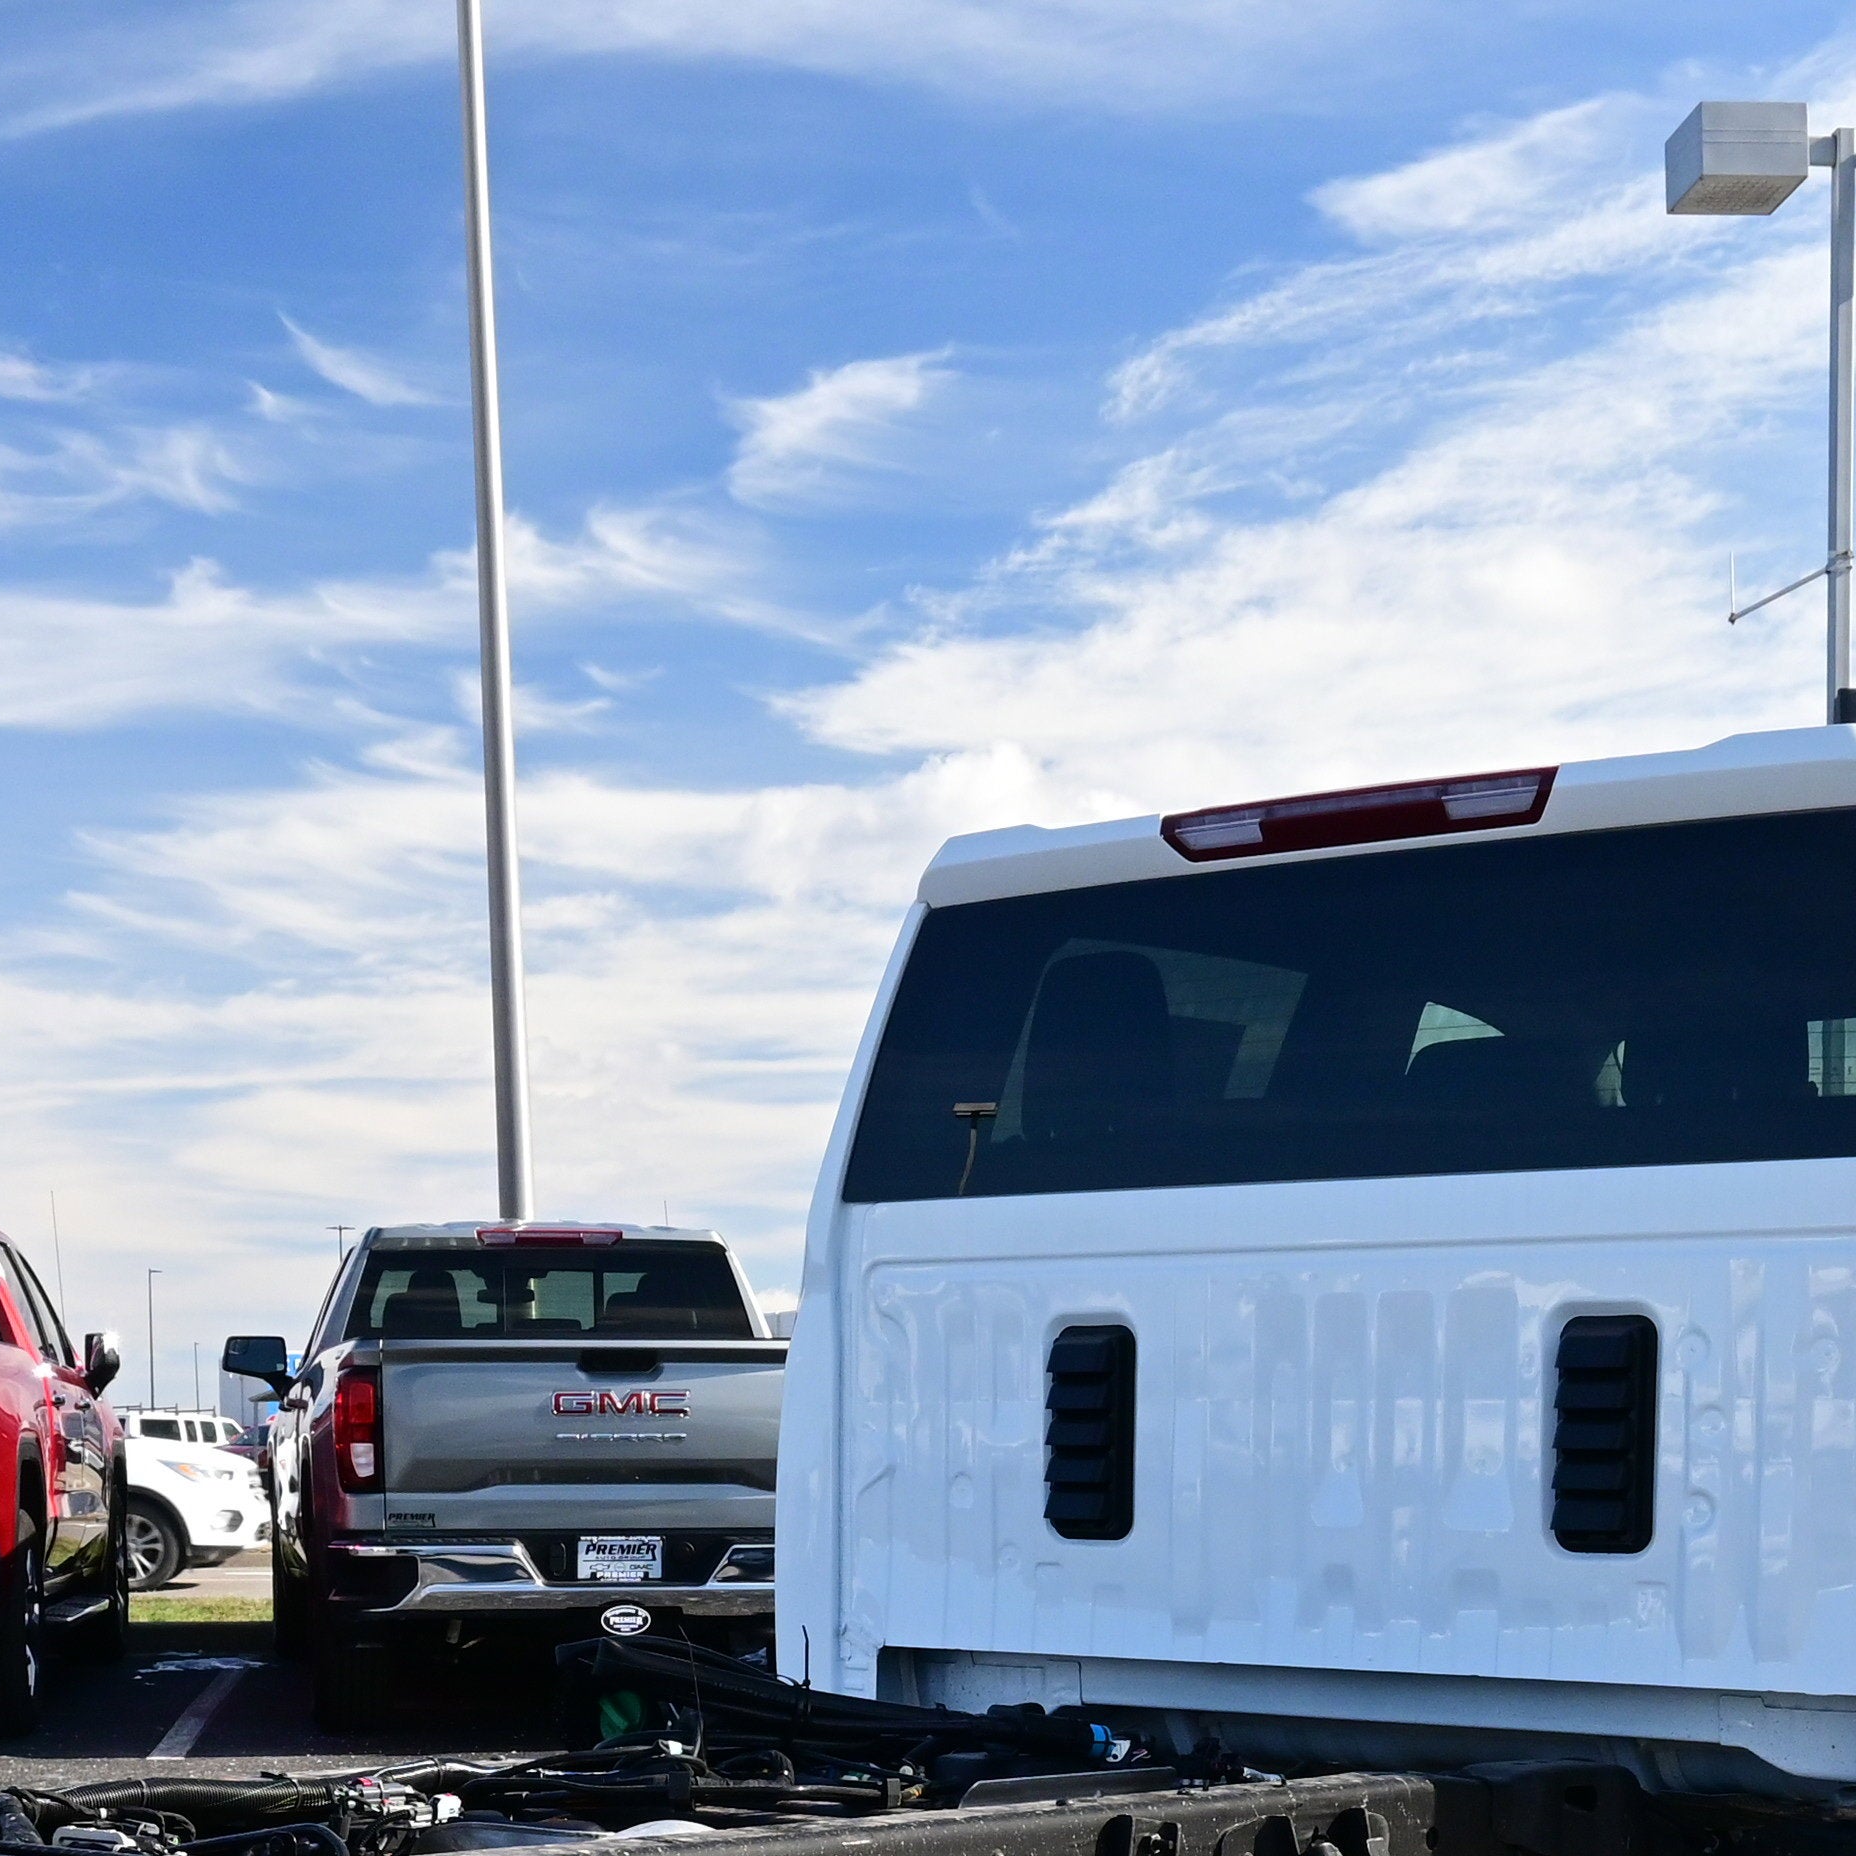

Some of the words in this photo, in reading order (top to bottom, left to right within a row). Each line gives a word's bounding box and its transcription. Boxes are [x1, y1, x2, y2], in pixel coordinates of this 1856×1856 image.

[551, 1390, 691, 1418] GMC
[387, 1512, 436, 1523] PREMIER
[585, 1543, 657, 1559] PREMIER
